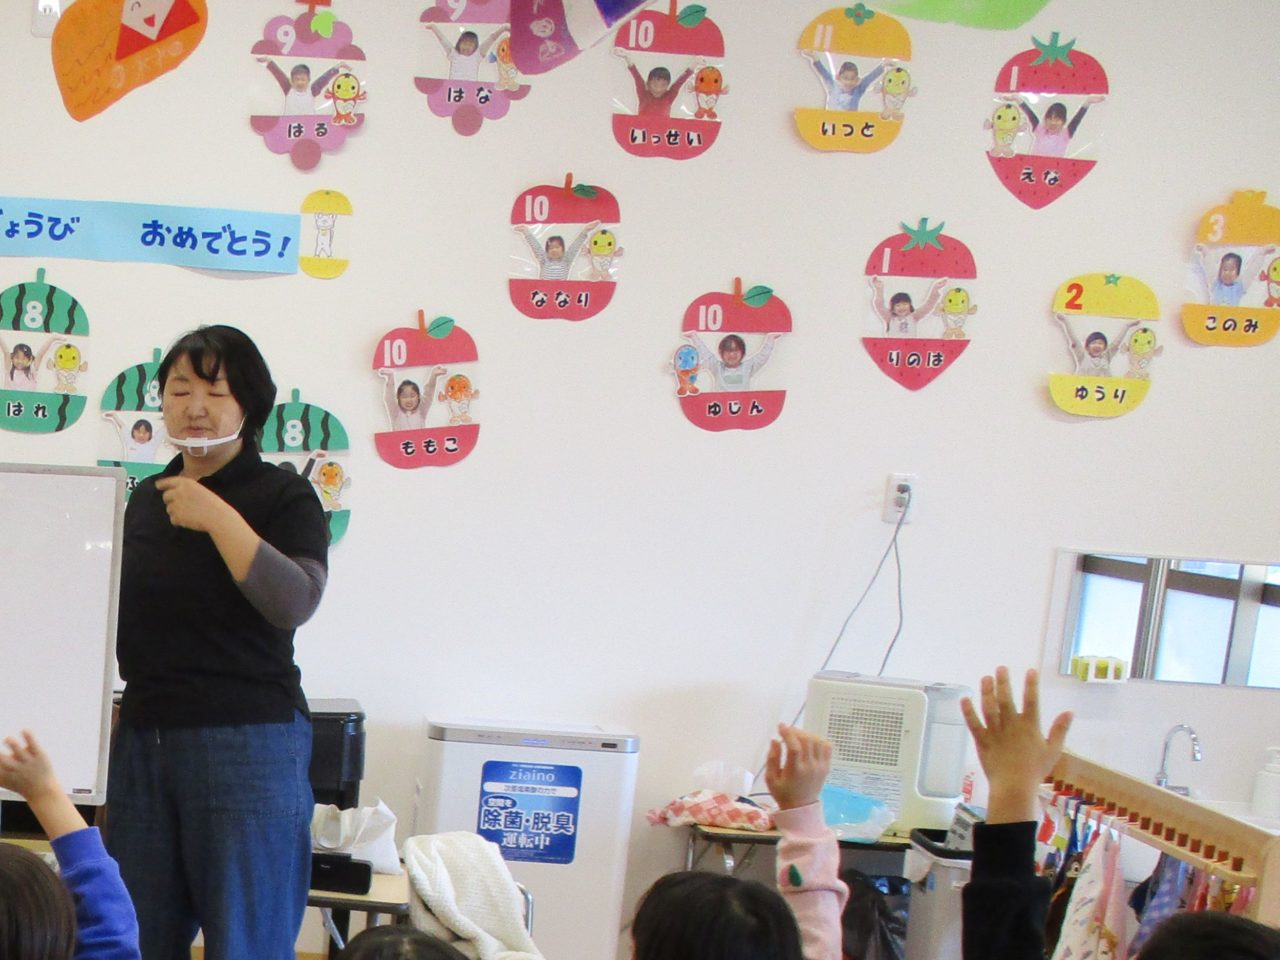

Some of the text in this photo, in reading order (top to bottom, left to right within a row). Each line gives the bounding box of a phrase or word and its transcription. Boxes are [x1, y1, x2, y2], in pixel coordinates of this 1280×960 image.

[276, 24, 296, 55] 9
[628, 20, 654, 48] 10
[447, 87, 493, 104] はな
[287, 122, 328, 138] はる
[630, 128, 702, 146] いっせい
[821, 121, 875, 138] いつと
[1021, 167, 1060, 186] えな
[525, 195, 549, 222] 10
[1207, 214, 1224, 242] 3
[140, 219, 291, 258] おめでとう!
[531, 290, 589, 308] ななり
[1065, 283, 1084, 310] 2
[24, 301, 43, 328] 8
[699, 305, 723, 331] 10
[1205, 316, 1258, 333] このみ
[384, 339, 407, 367] 10
[888, 351, 944, 367] りのは
[145, 380, 163, 407] 8
[1075, 385, 1126, 404] ゆうり
[7, 402, 48, 418] はれ
[707, 401, 764, 417] ゆじん
[283, 419, 304, 448] 8
[402, 437, 459, 456] ももこ
[508, 768, 556, 782] ziaino
[481, 808, 575, 835] 除菌・脱臭
[502, 832, 550, 849] 運転中
